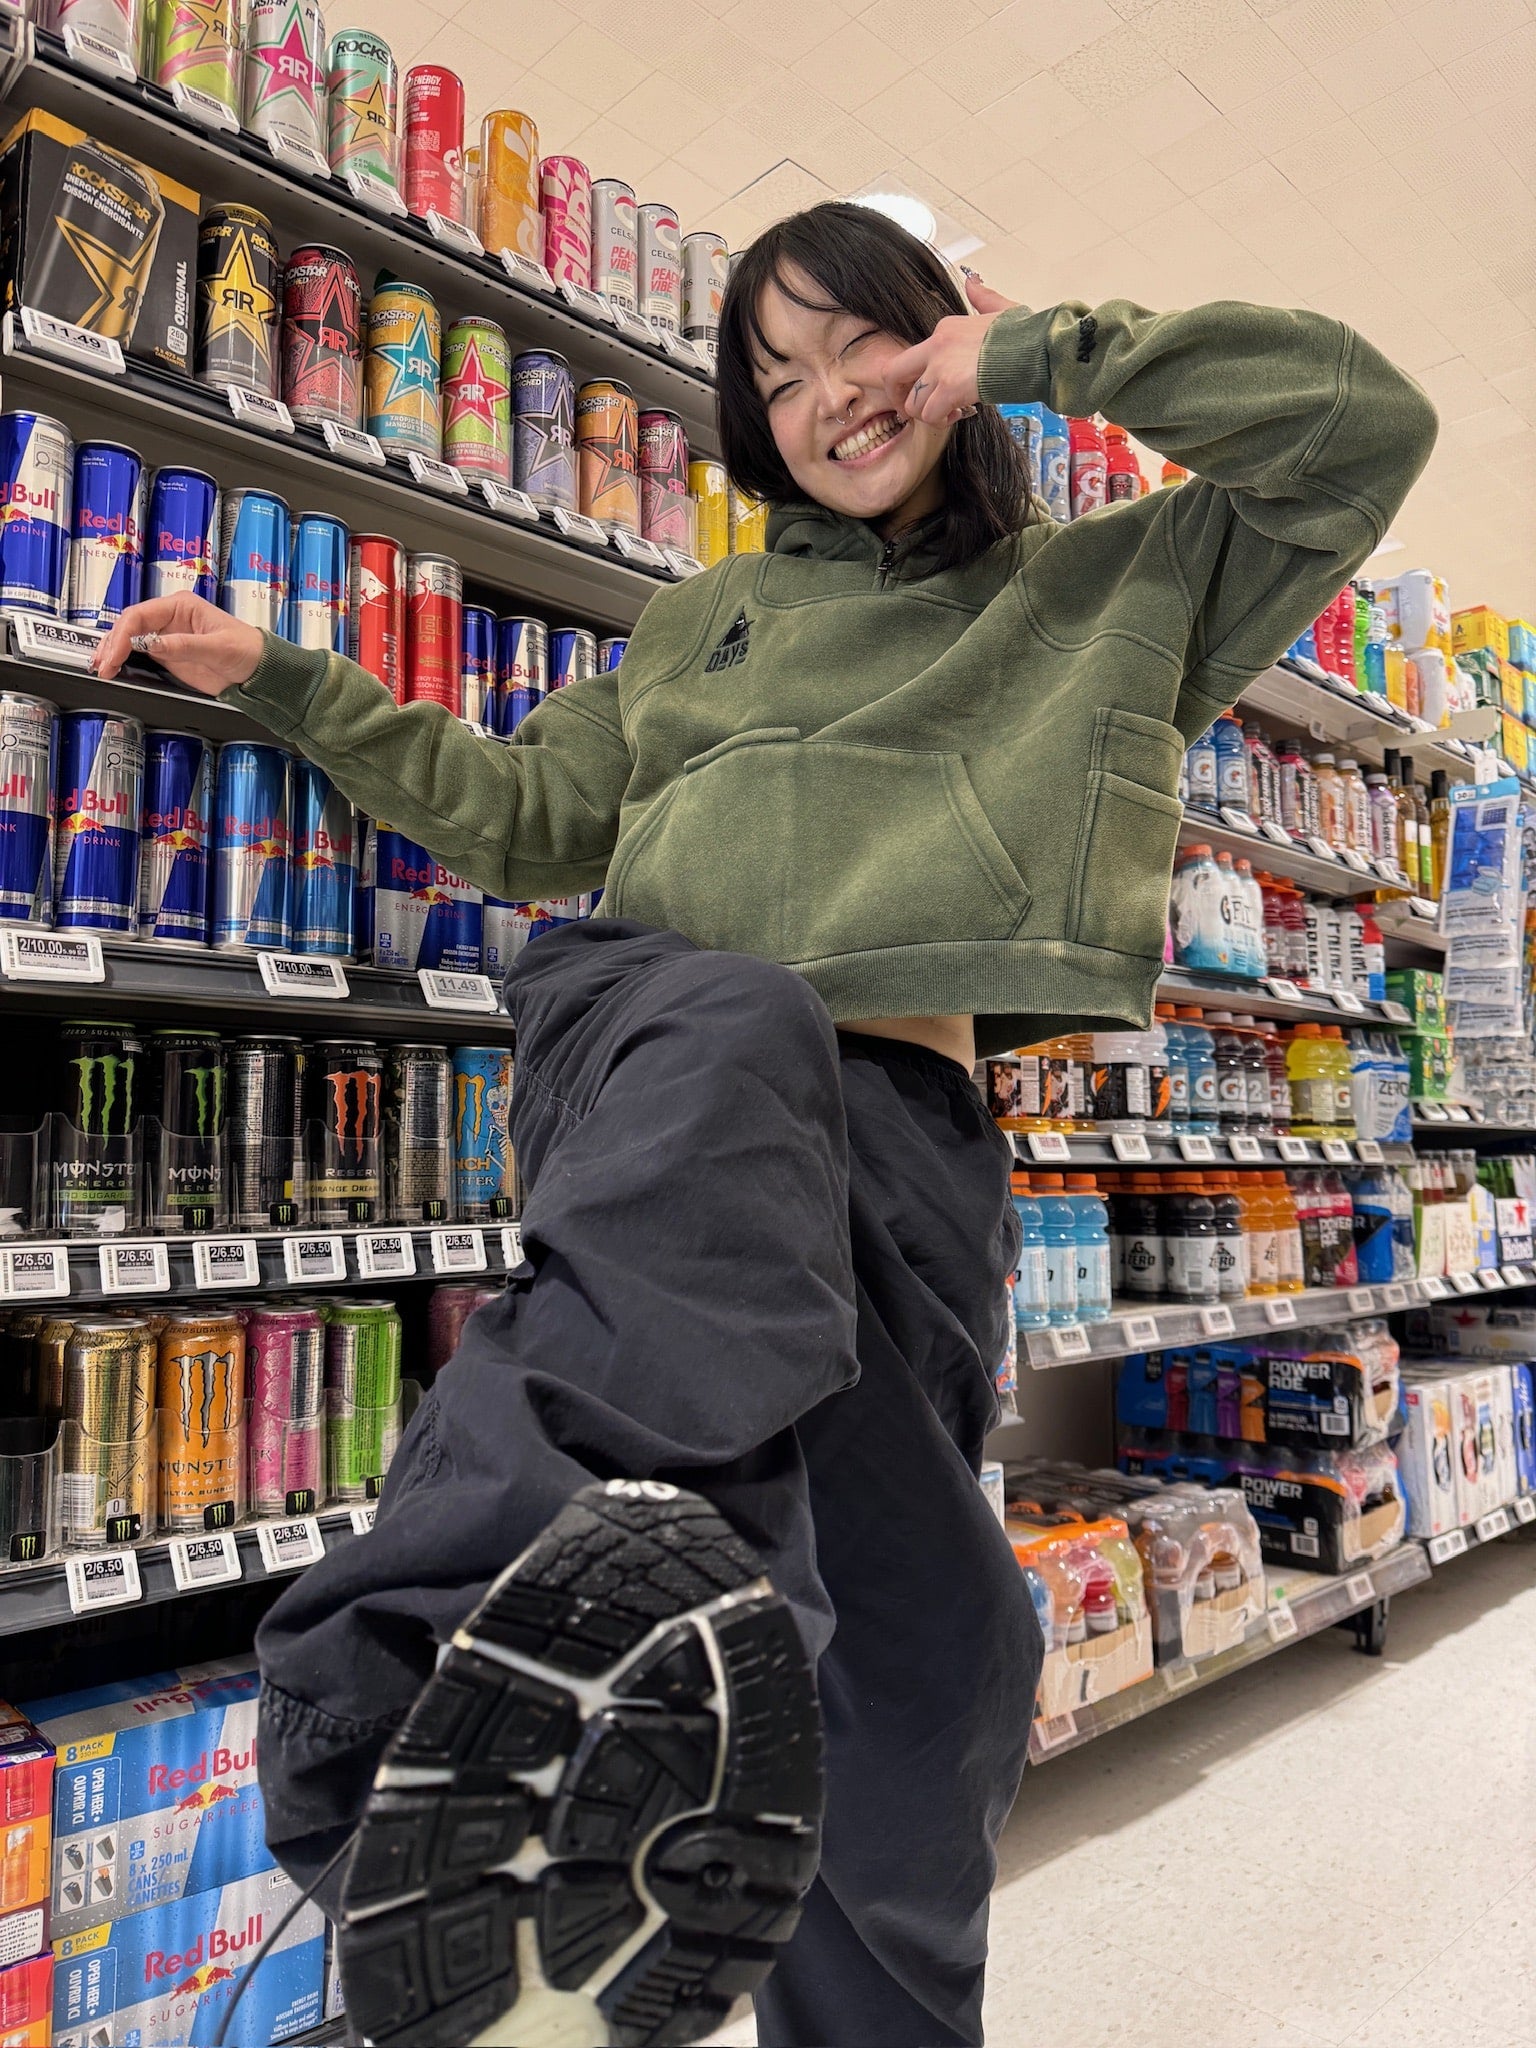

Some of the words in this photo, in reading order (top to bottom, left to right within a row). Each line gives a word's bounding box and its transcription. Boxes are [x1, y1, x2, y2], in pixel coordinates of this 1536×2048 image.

[63, 183, 94, 207] BOISSON
[65, 173, 99, 196] ENERGY
[99, 193, 133, 220] DRINK
[69, 161, 152, 224] ROCKSTAR
[174, 261, 187, 326] ORIGINAL
[650, 280, 673, 294] VIBE
[48, 322, 101, 348] 11.49
[12, 483, 56, 511] Bull
[79, 509, 122, 531] Red
[12, 525, 48, 538] DRINK
[159, 531, 200, 555] Red
[36, 624, 79, 643] 2/8.50
[512, 663, 540, 681] Bull
[82, 789, 128, 816] Bull
[225, 816, 269, 838] Red
[83, 836, 121, 848] DRINK
[392, 857, 431, 885] Red
[395, 902, 434, 915] ENERGY
[20, 937, 63, 955] 2/10.00
[276, 961, 312, 975] 2/10.00
[439, 977, 477, 992] 11.49
[300, 1242, 331, 1255] 2/6.50
[373, 1238, 400, 1250] 2/6.50
[446, 1235, 472, 1247] 2/6.50
[15, 1253, 53, 1267] 2/6.50
[119, 1250, 153, 1264] 2/6.50
[211, 1246, 243, 1259] 2/6.50
[1127, 1254, 1156, 1267] ZERO
[1269, 1360, 1331, 1380] POWER
[1240, 1475, 1303, 1500] POWER
[275, 1524, 306, 1540] 2/6.50
[188, 1539, 222, 1556] 2/6.50
[85, 1559, 122, 1576] 2/6.50
[66, 1746, 78, 1763] 8
[80, 1740, 104, 1753] PACK
[91, 1767, 106, 1793] OPEN
[149, 1751, 207, 1796] Red
[73, 1775, 87, 1813] OUVRIR
[91, 1793, 104, 1818] HERE
[153, 1798, 259, 1840] SUGARFREE
[129, 1863, 137, 1878] 8
[151, 1853, 173, 1872] 250
[174, 1848, 189, 1863] mL
[61, 1939, 73, 1956] 8
[75, 1931, 99, 1945] PACK
[144, 1934, 204, 1985] Red
[209, 1913, 263, 1960] Bull
[87, 1959, 101, 1984] OPEN
[68, 1969, 82, 2004] OUVRIR
[86, 1984, 99, 2010] HERE
[150, 1980, 255, 2027] SUGARFRE
